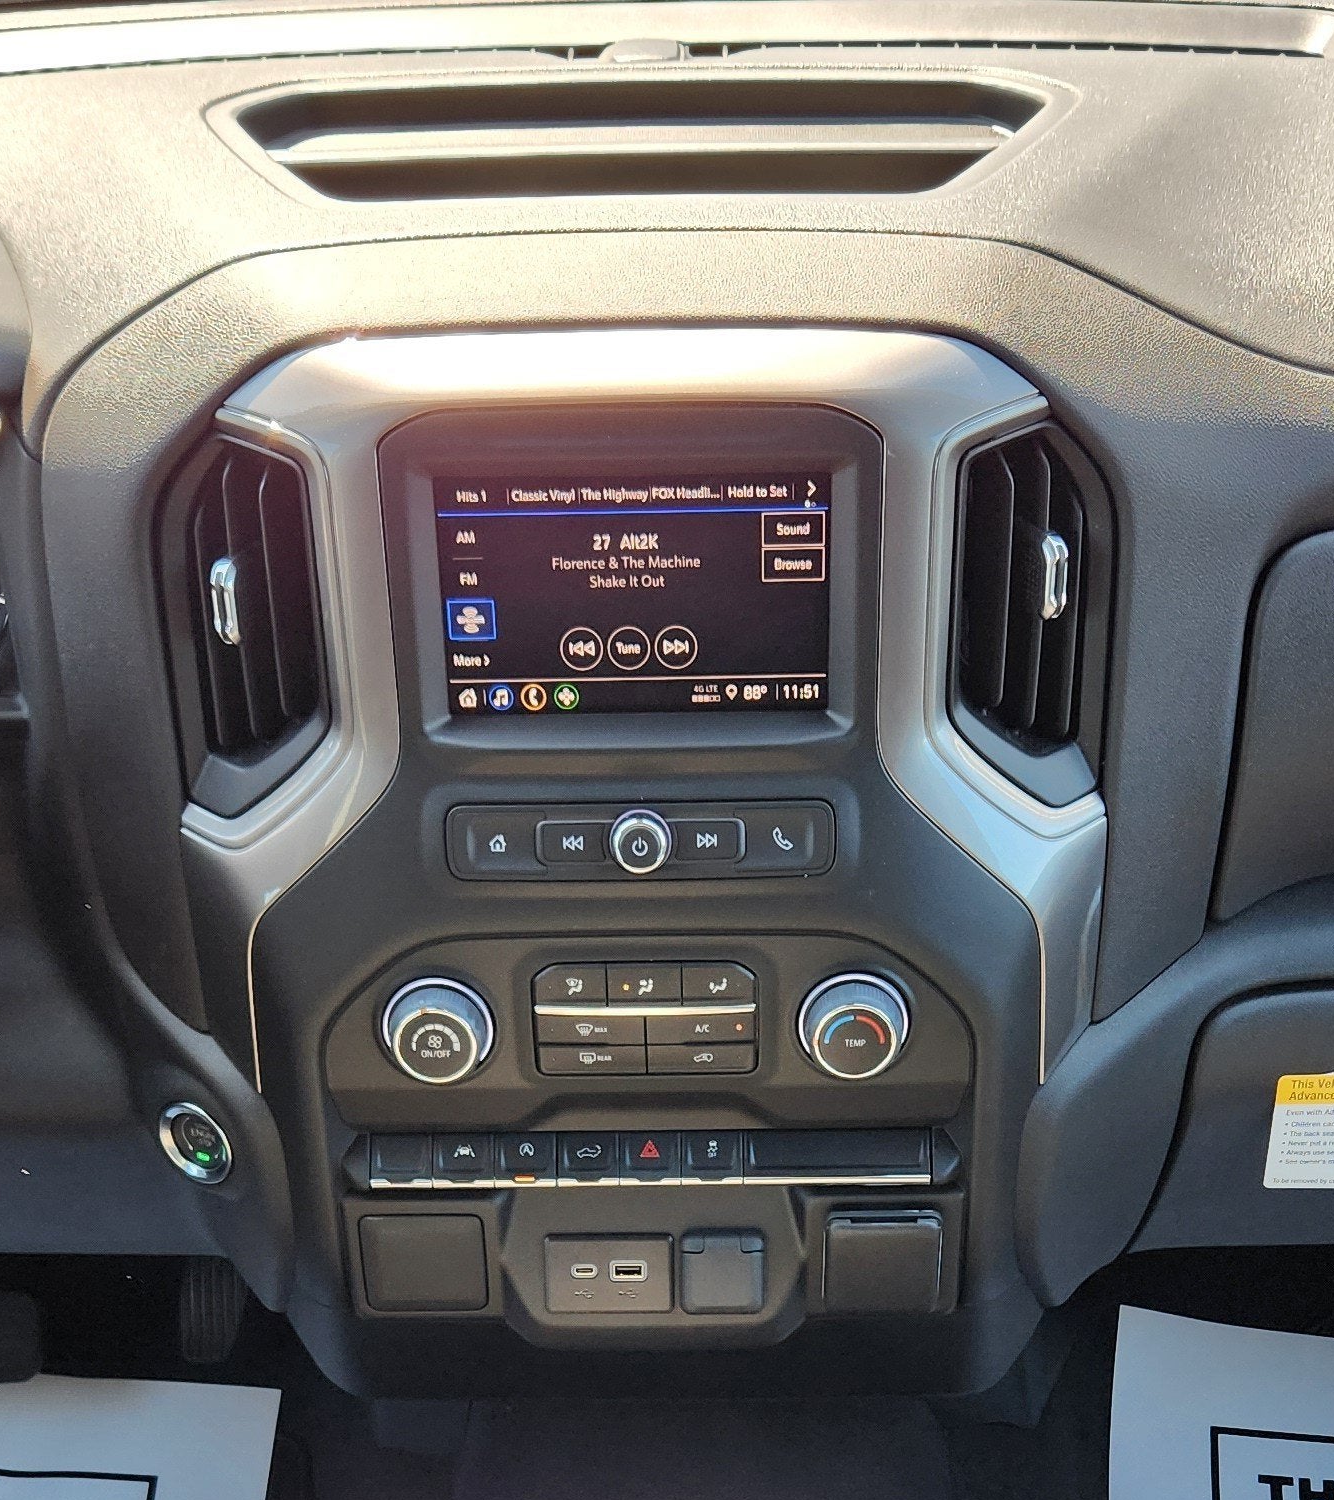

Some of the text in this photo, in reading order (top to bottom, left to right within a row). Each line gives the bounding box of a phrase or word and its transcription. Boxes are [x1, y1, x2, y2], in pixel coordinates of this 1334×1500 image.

[456, 489, 479, 503] Hits
[511, 487, 576, 504] Classic Vinyl
[580, 486, 648, 503] The Highway
[651, 486, 676, 500] FOX
[727, 484, 788, 499] Hold to Set
[776, 521, 810, 537] Sound
[456, 531, 476, 545] AM
[592, 532, 659, 550] 27 Alt2K
[551, 554, 701, 571] Florence & The Machine
[774, 557, 813, 572] Browse
[459, 572, 478, 586] FM
[589, 574, 665, 589] Shake It Out
[616, 641, 641, 656] Tune
[453, 653, 482, 667] More
[705, 684, 719, 693] LTE
[783, 683, 820, 700] 11:51
[694, 1024, 710, 1034] A/C
[844, 1038, 867, 1048] TEMP
[420, 1050, 451, 1059] ON/OFF
[1291, 1079, 1314, 1090] This
[1290, 1130, 1302, 1138] The
[1309, 1140, 1322, 1148] put
[1286, 1149, 1311, 1157] Always
